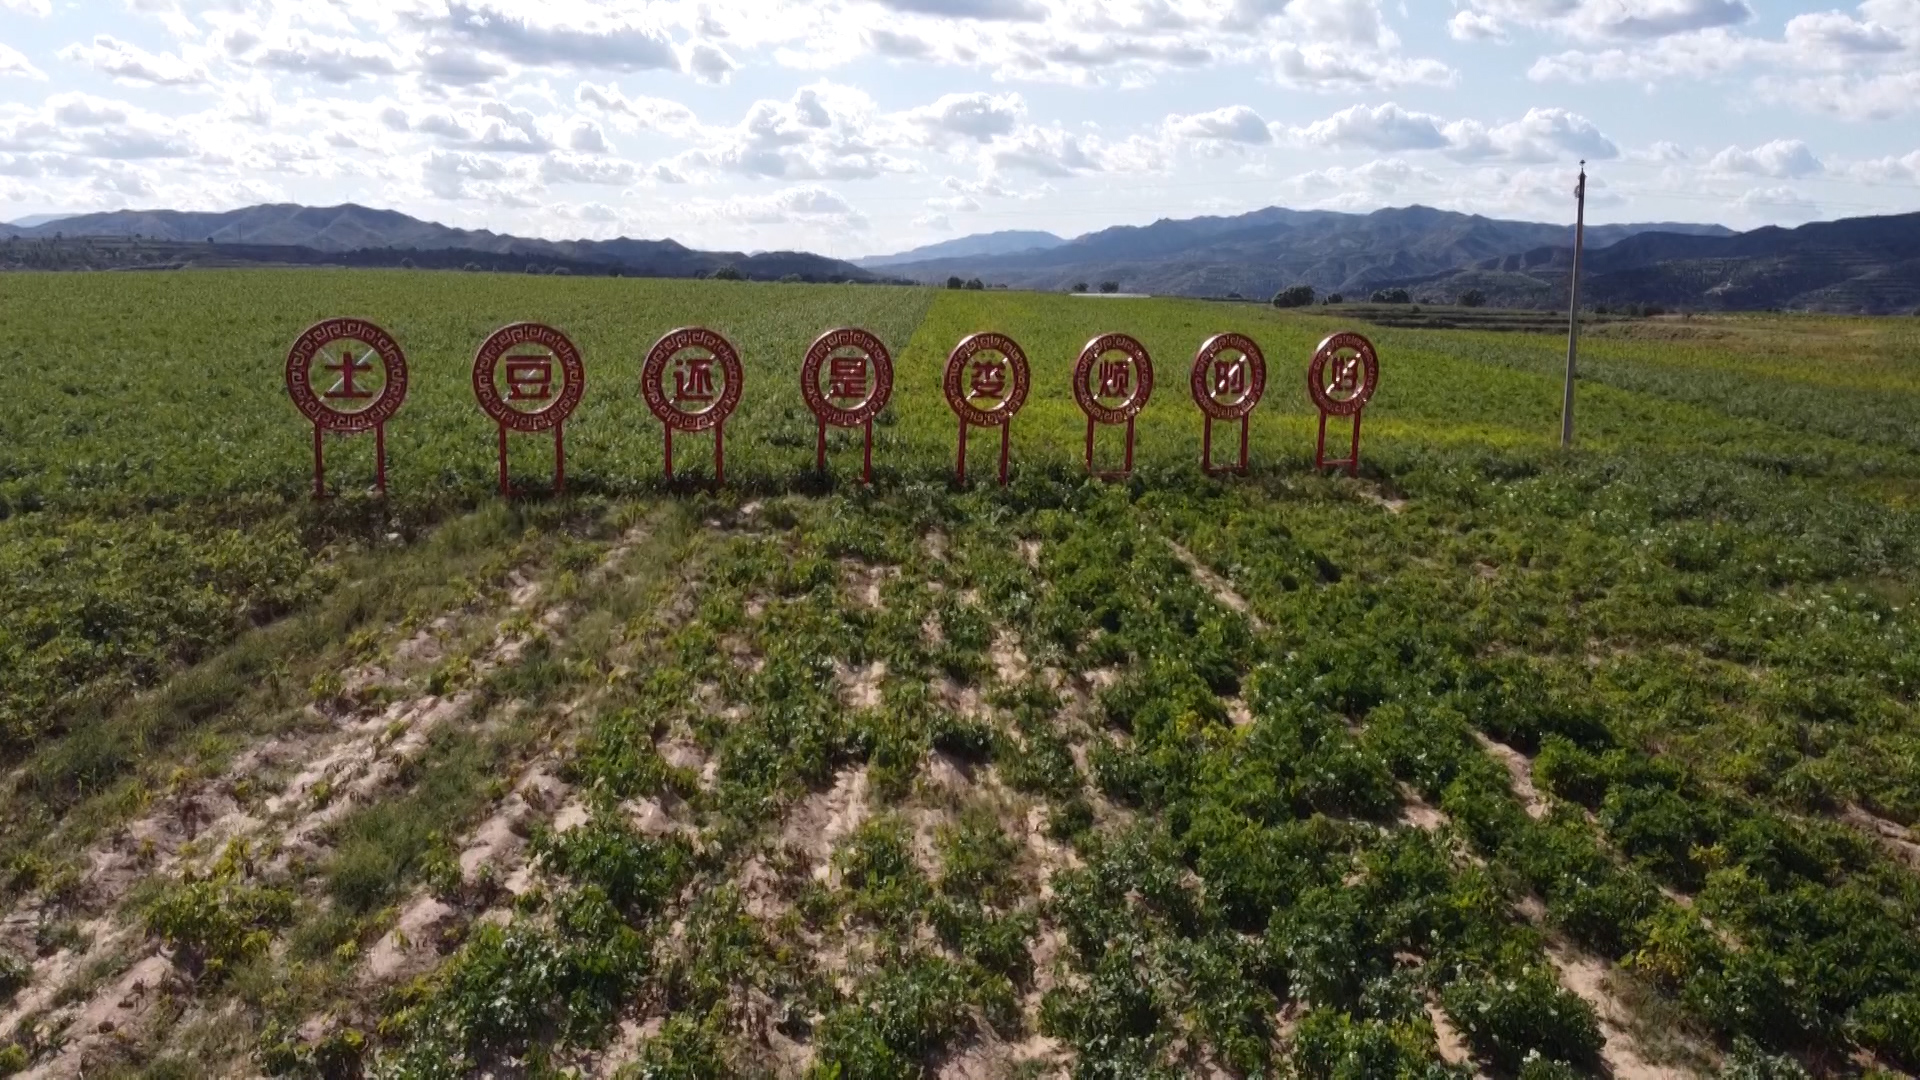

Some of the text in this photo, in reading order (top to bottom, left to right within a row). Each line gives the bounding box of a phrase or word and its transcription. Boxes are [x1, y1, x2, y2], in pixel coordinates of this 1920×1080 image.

[323, 351, 373, 399] 土
[506, 355, 552, 400] 豆
[673, 358, 714, 401] 还
[830, 357, 867, 398] 是
[971, 361, 1006, 398] 娄
[1098, 359, 1130, 398] 烦
[1214, 359, 1245, 394] 的
[1331, 356, 1359, 391] 好
